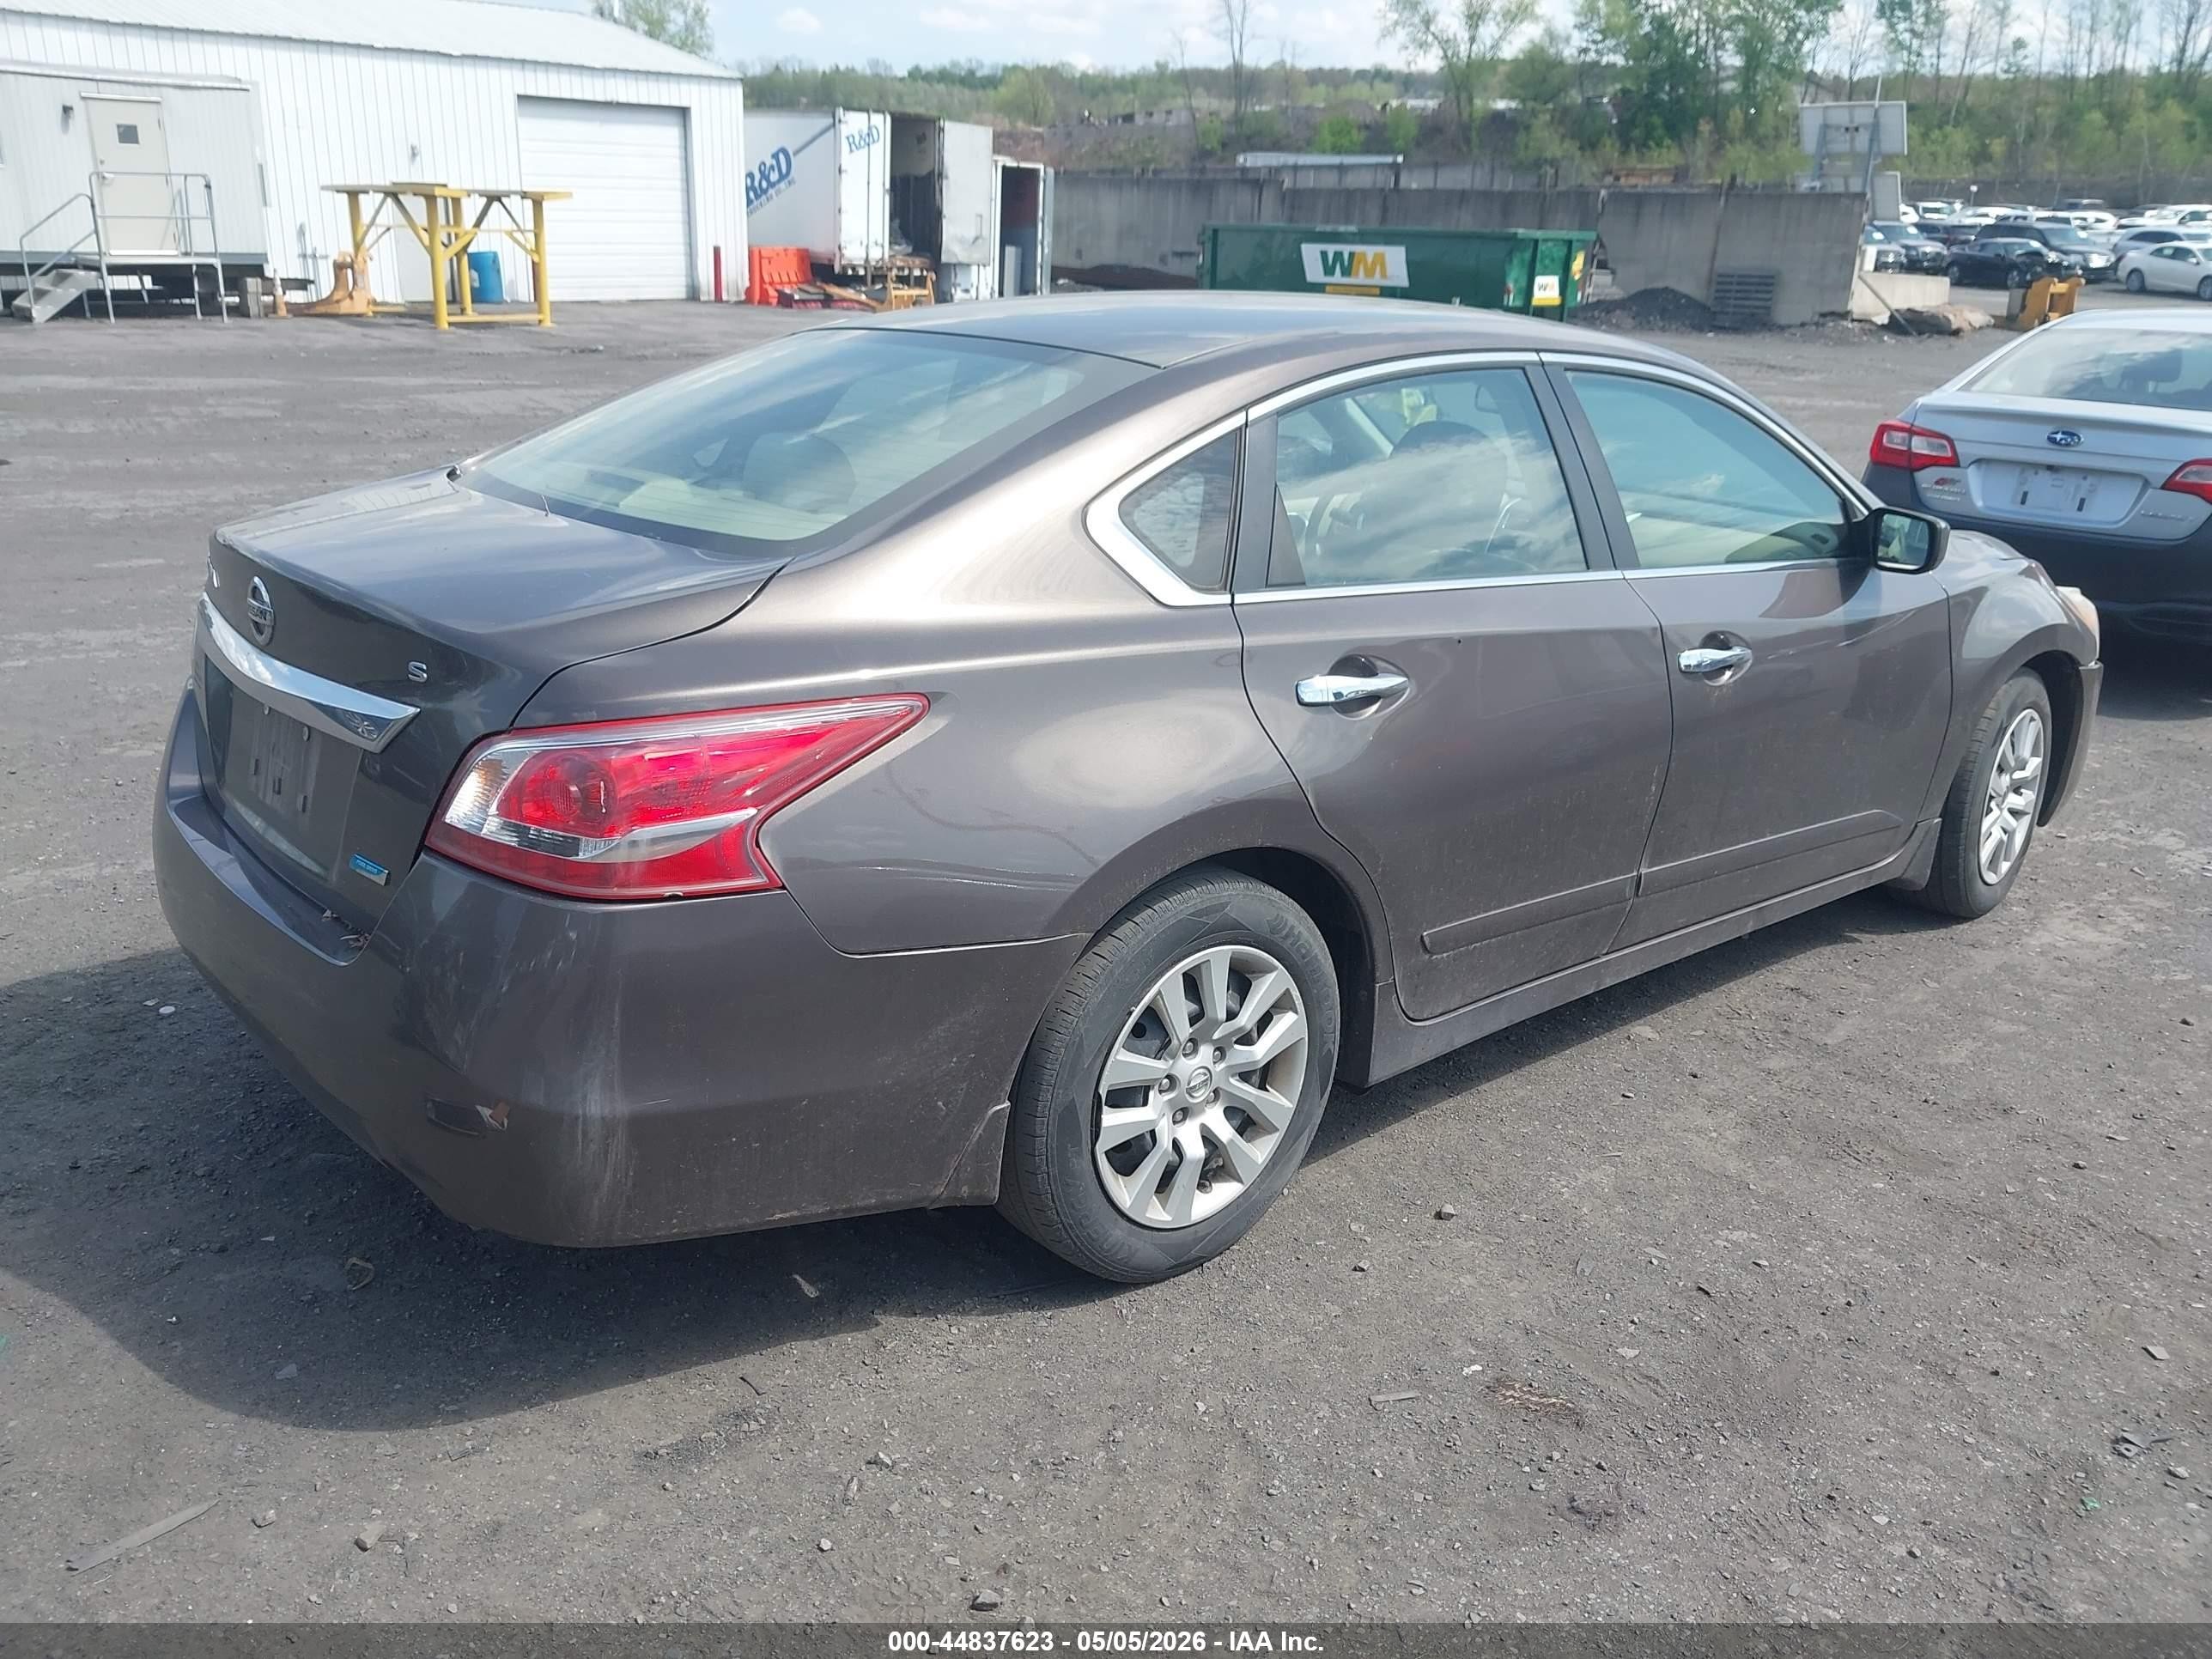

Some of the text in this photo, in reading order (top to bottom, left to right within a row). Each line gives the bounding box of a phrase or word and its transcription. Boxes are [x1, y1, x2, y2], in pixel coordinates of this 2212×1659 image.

[846, 125, 880, 154] R&D
[745, 145, 792, 208] R&D
[1320, 250, 1388, 280] WM
[408, 661, 428, 683] S
